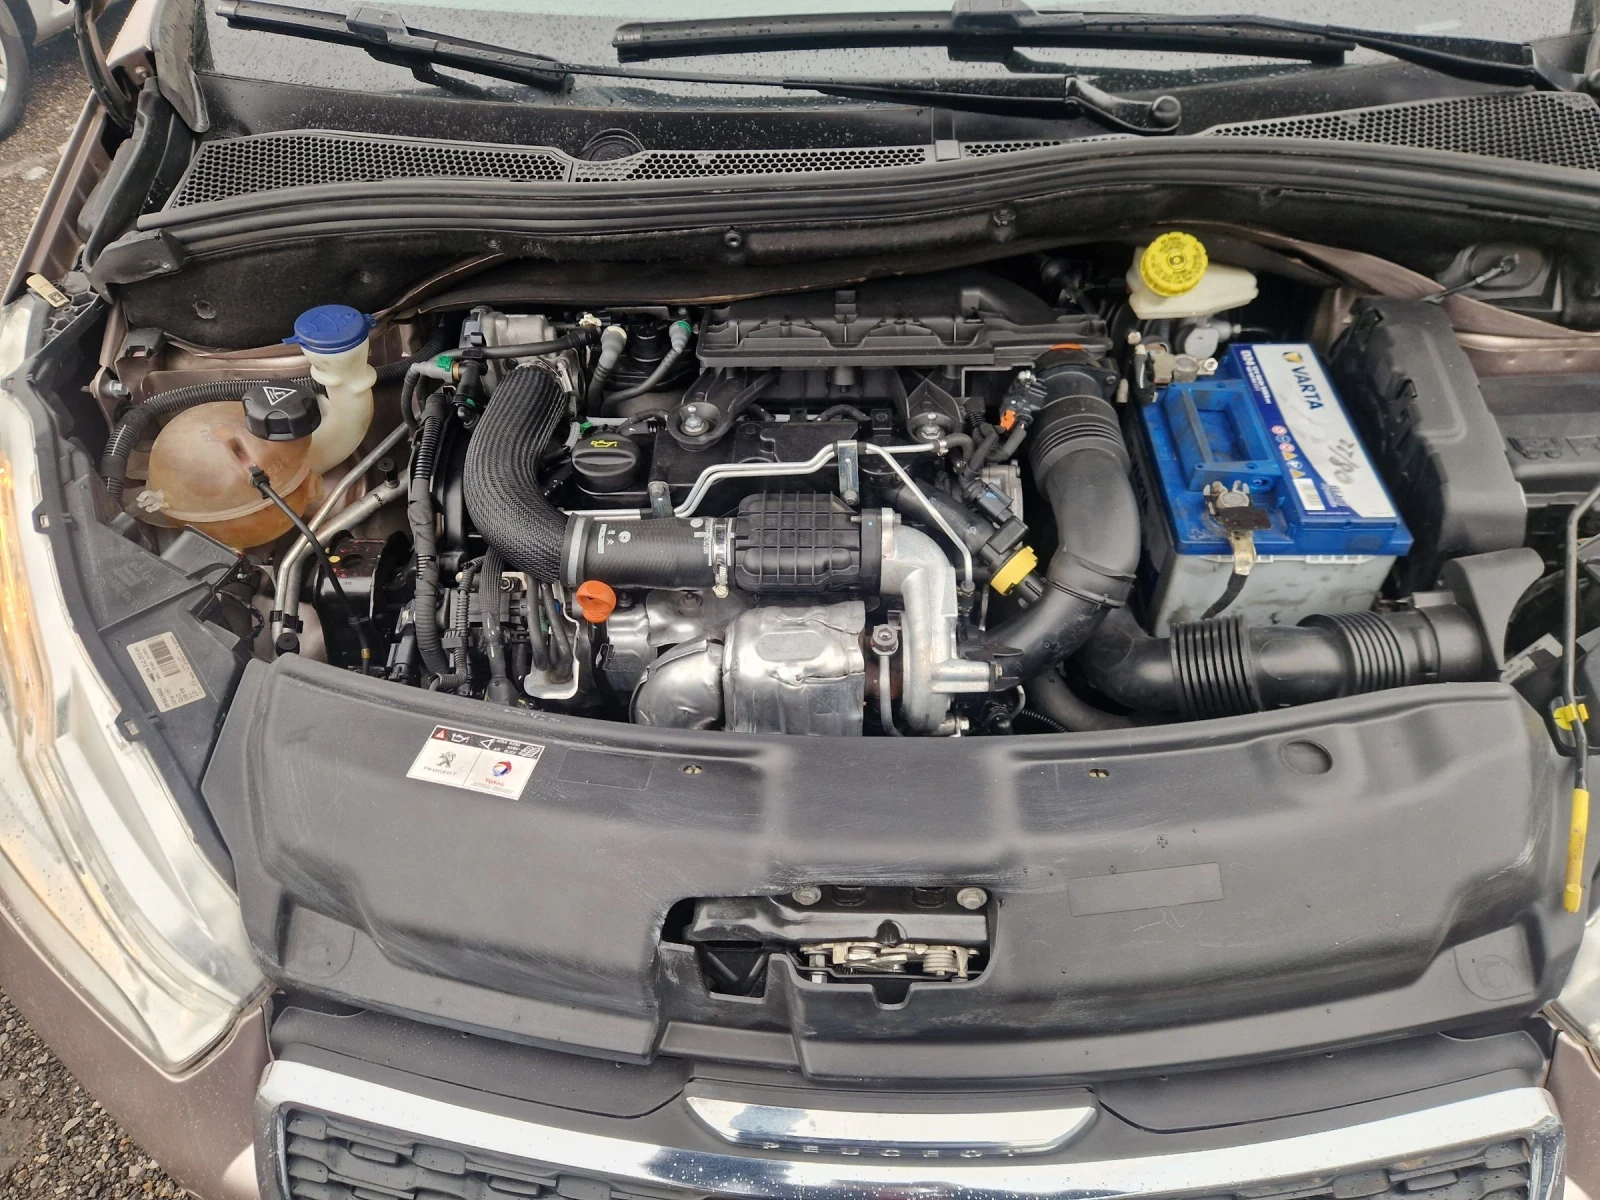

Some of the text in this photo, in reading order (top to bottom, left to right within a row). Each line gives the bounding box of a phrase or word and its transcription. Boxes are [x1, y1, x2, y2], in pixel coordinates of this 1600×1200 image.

[1291, 365, 1325, 410] VARTA
[423, 765, 458, 776] PEUGEOT
[484, 778, 505, 787] TOTAL
[762, 1141, 1023, 1158] PEUGEOT
